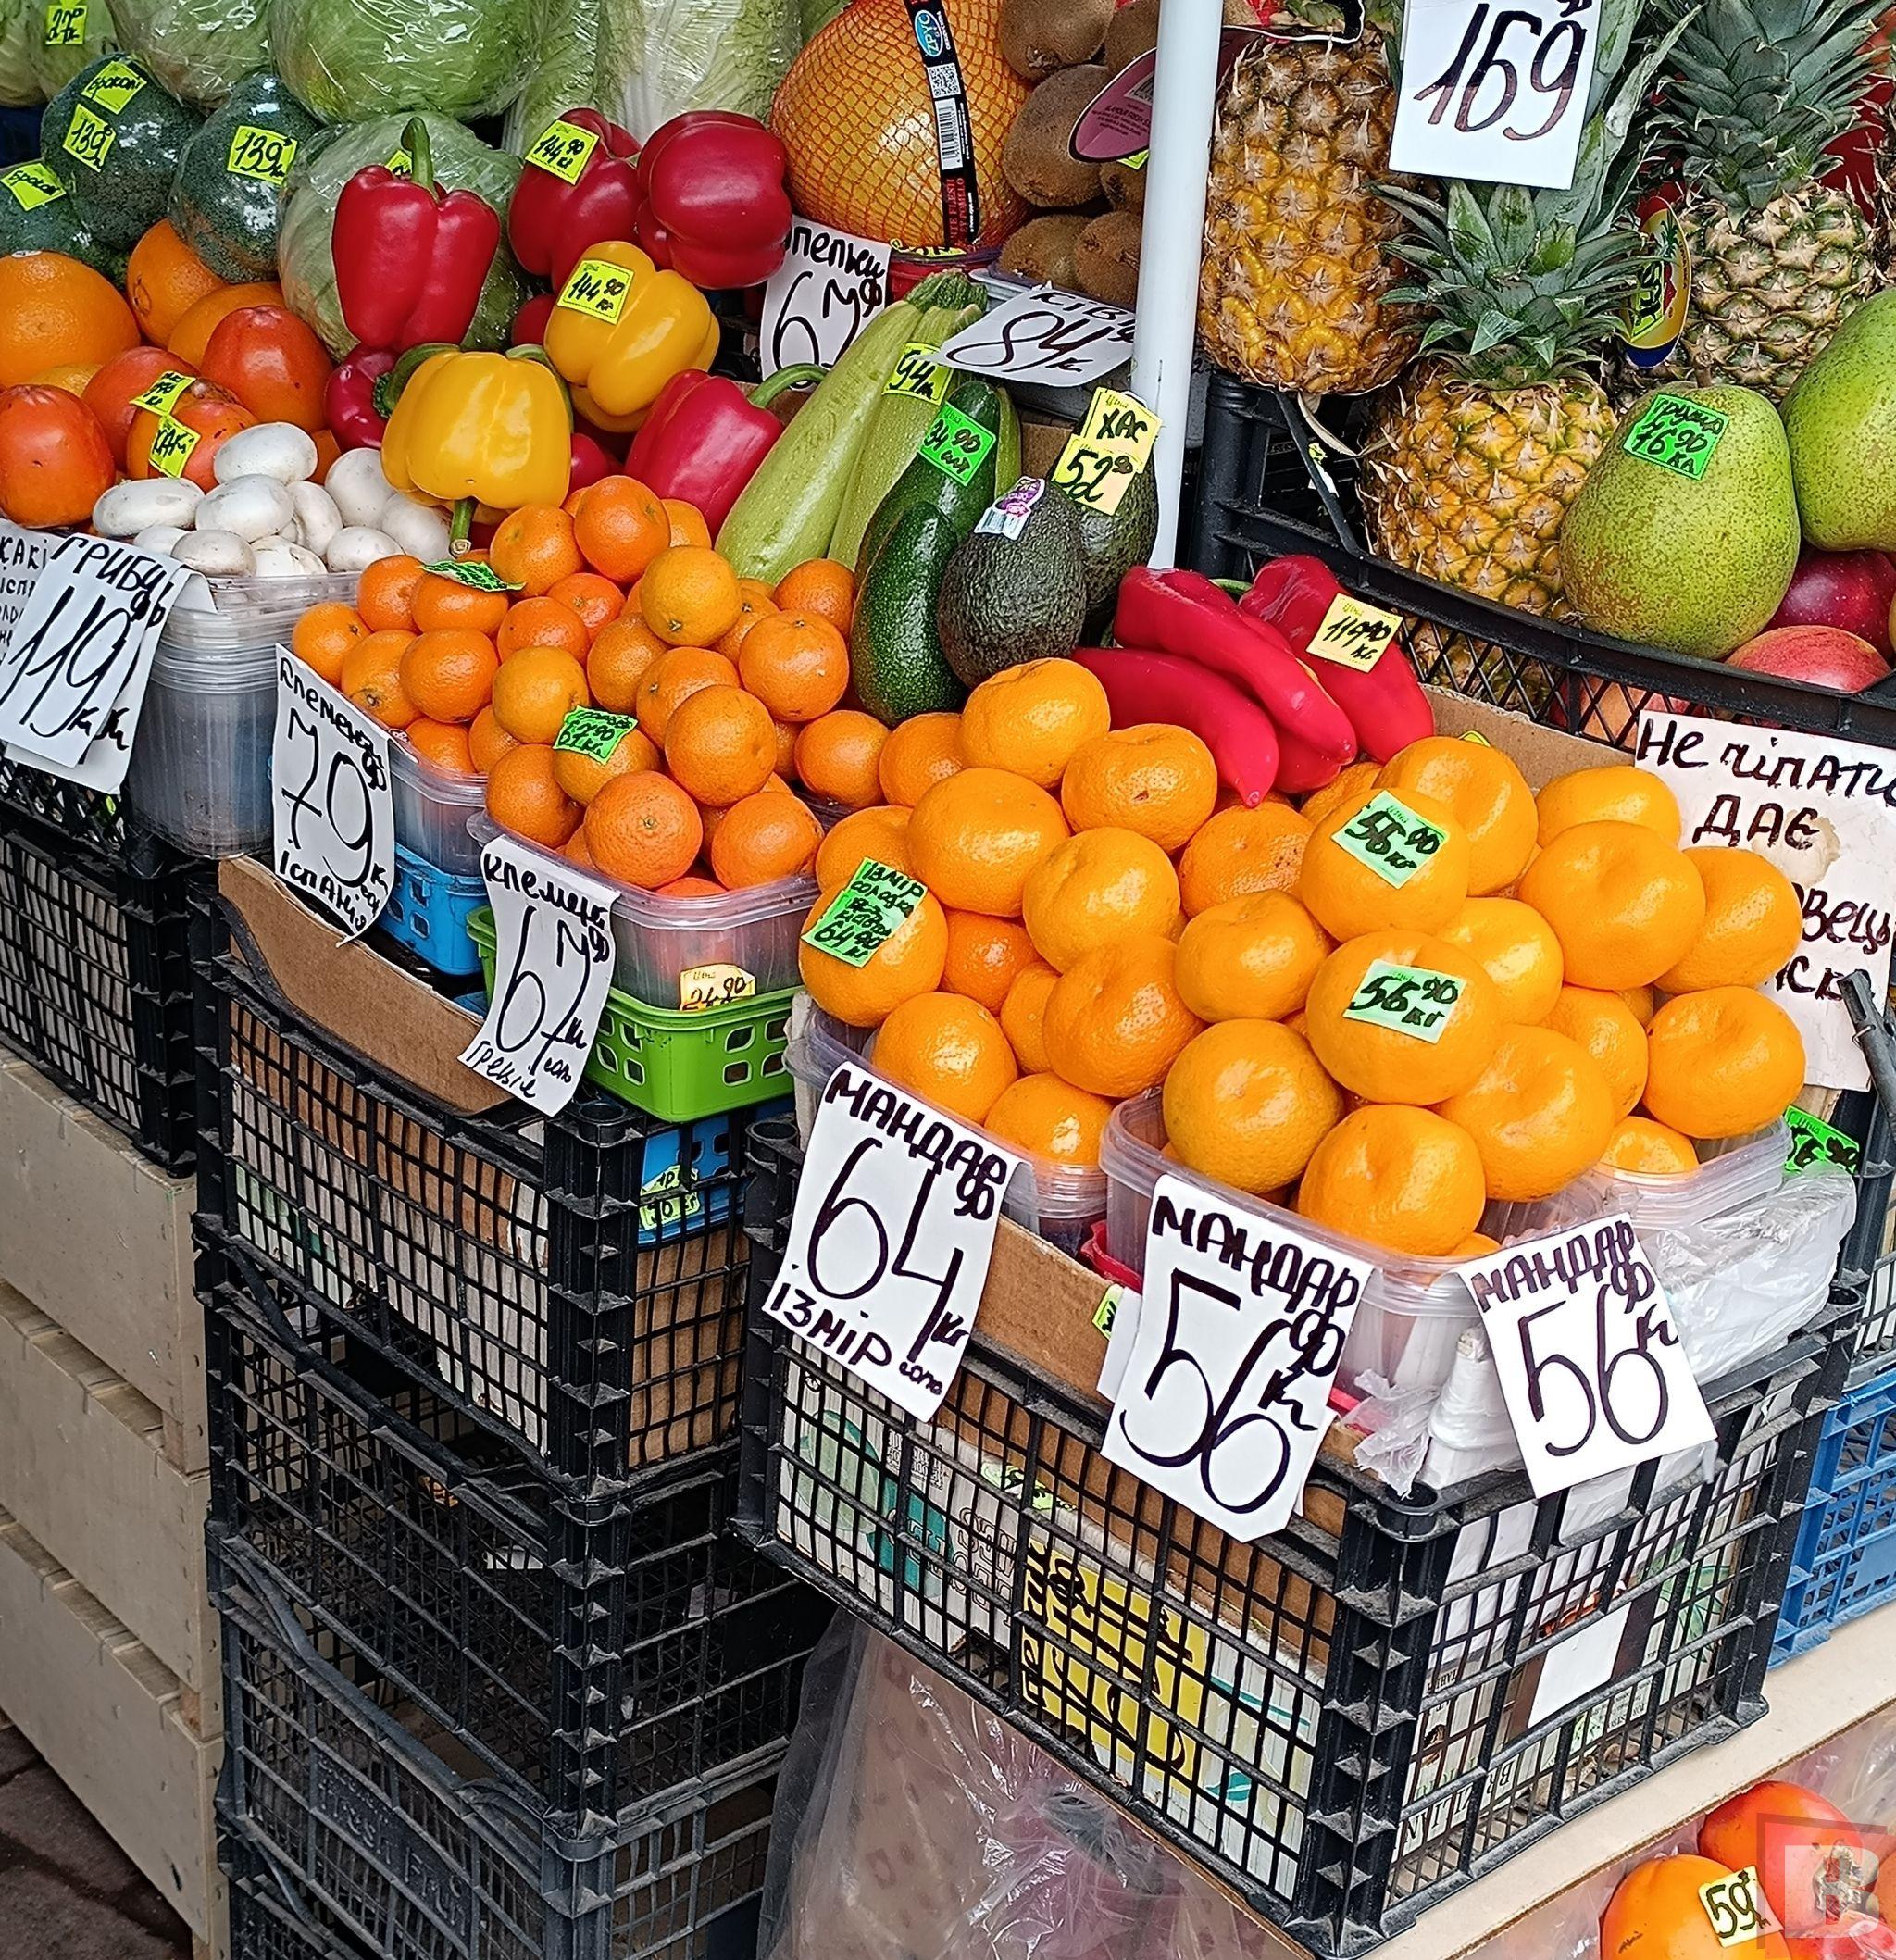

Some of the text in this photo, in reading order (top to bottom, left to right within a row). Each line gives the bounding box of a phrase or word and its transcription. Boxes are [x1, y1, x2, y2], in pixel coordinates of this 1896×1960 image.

[1414, 3, 1587, 140] 169
[1348, 976, 1422, 1012] 56
[807, 1137, 964, 1363] 64
[1152, 1195, 1360, 1317] МАНДАР
[1119, 1267, 1291, 1515] 56
[1517, 1283, 1669, 1457] 56
[1705, 1883, 1757, 1939] 59
